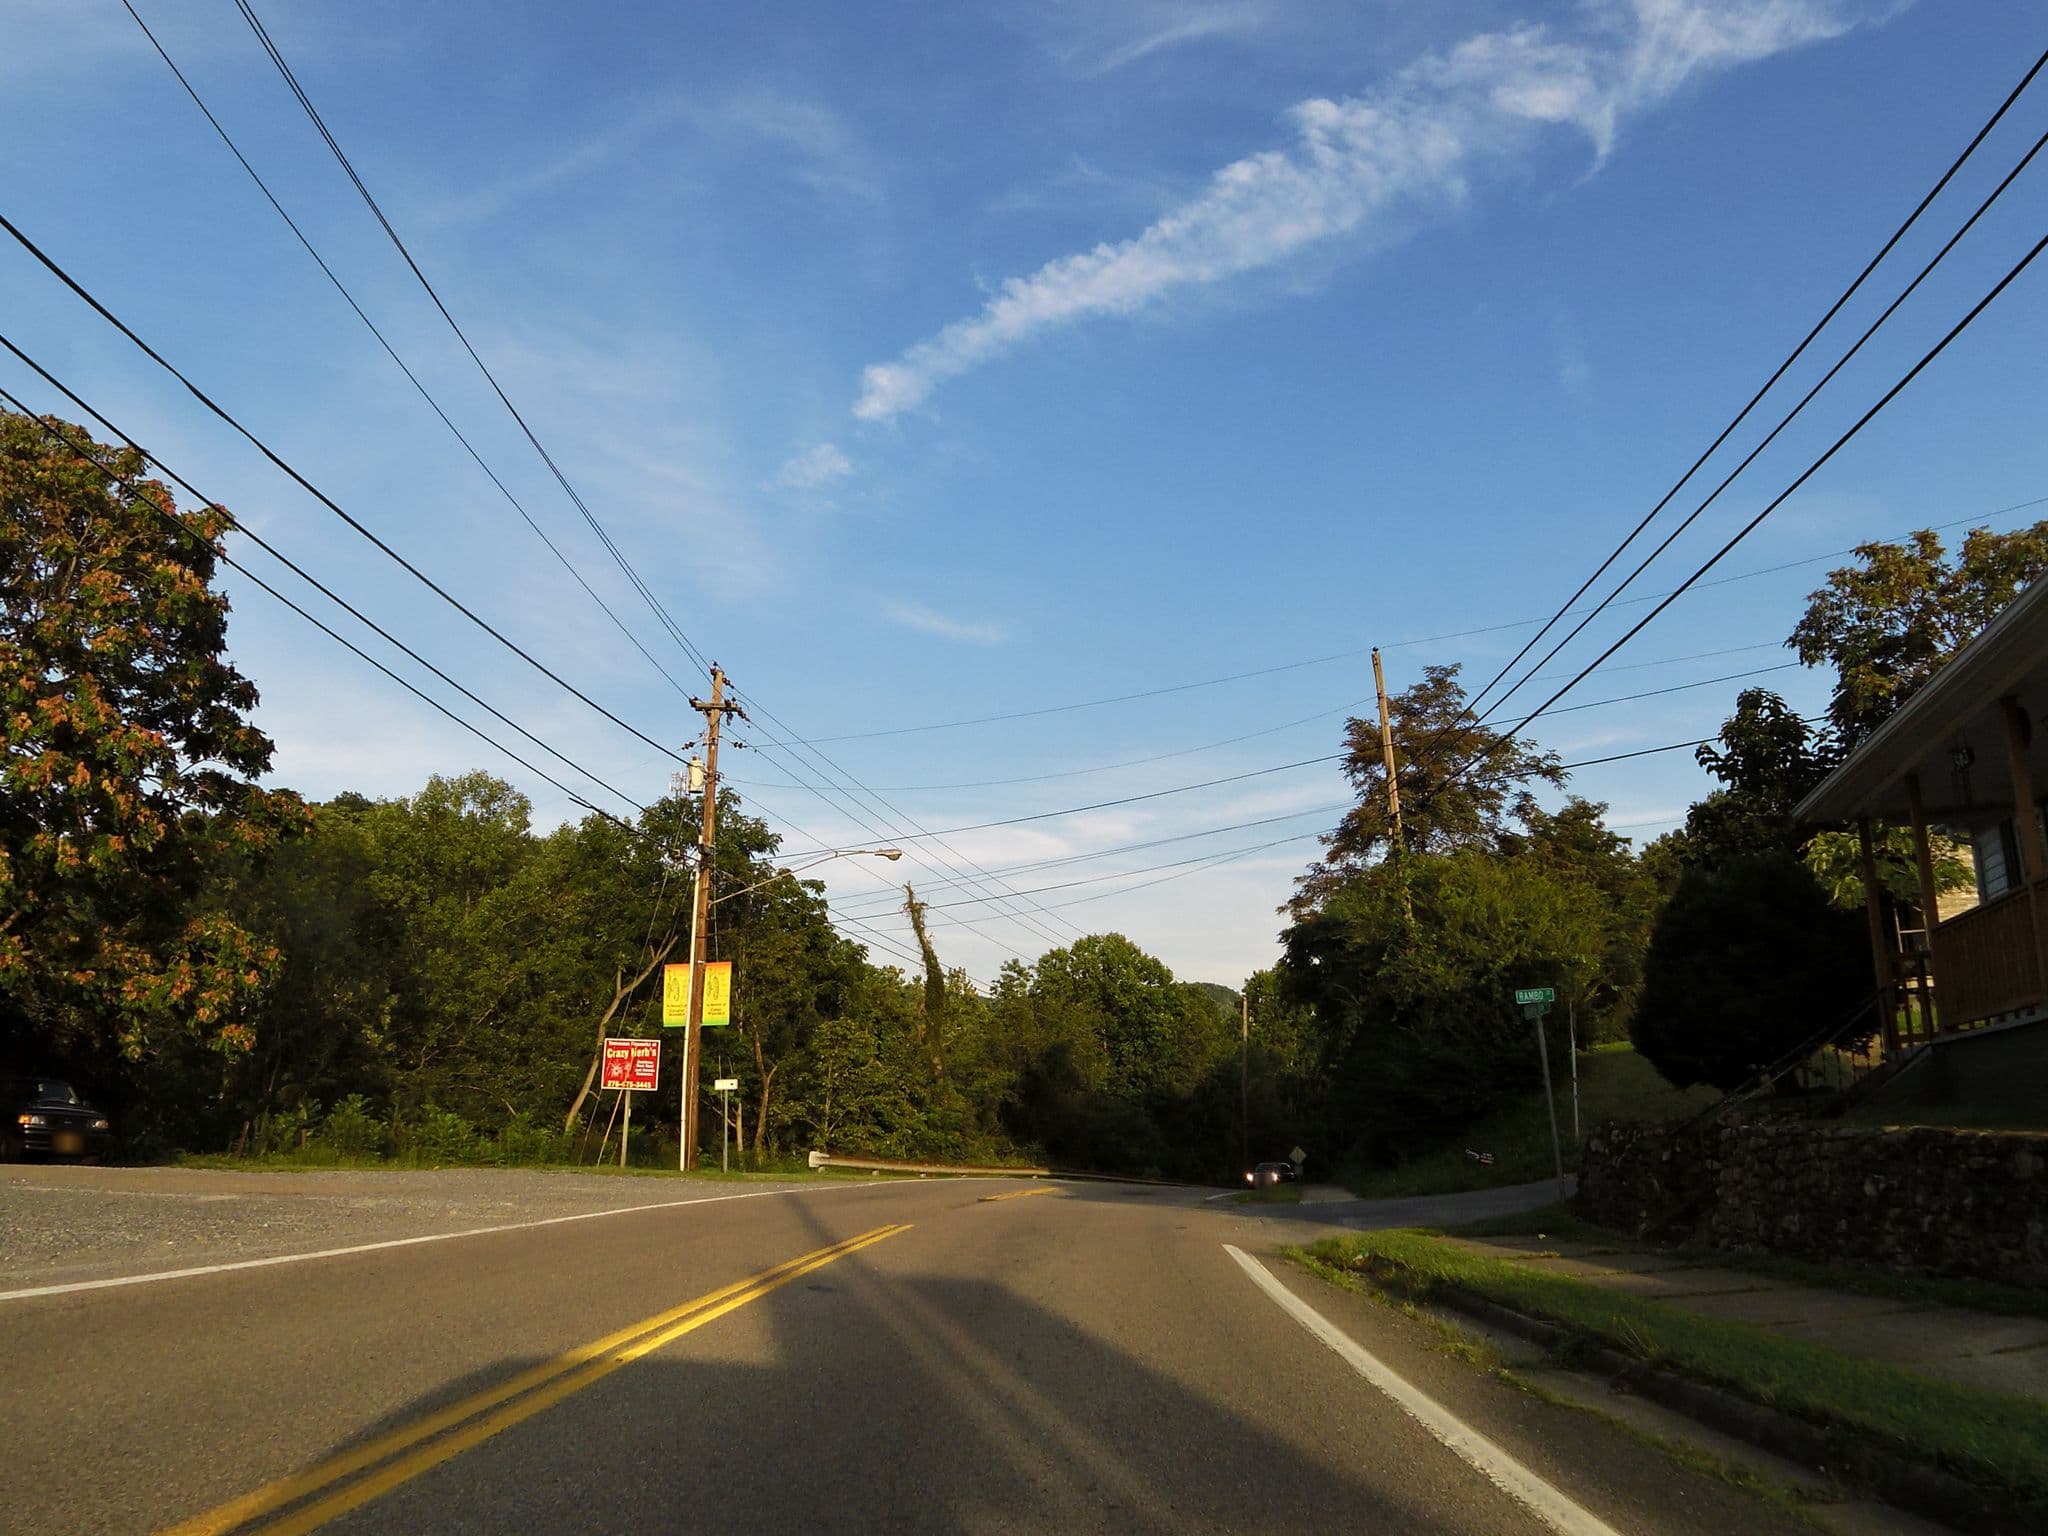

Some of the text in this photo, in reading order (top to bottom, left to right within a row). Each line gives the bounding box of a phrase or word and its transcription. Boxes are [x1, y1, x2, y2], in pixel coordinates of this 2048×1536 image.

[1518, 990, 1544, 1001] RAMBO
[607, 1047, 657, 1060] Crazy Herb's
